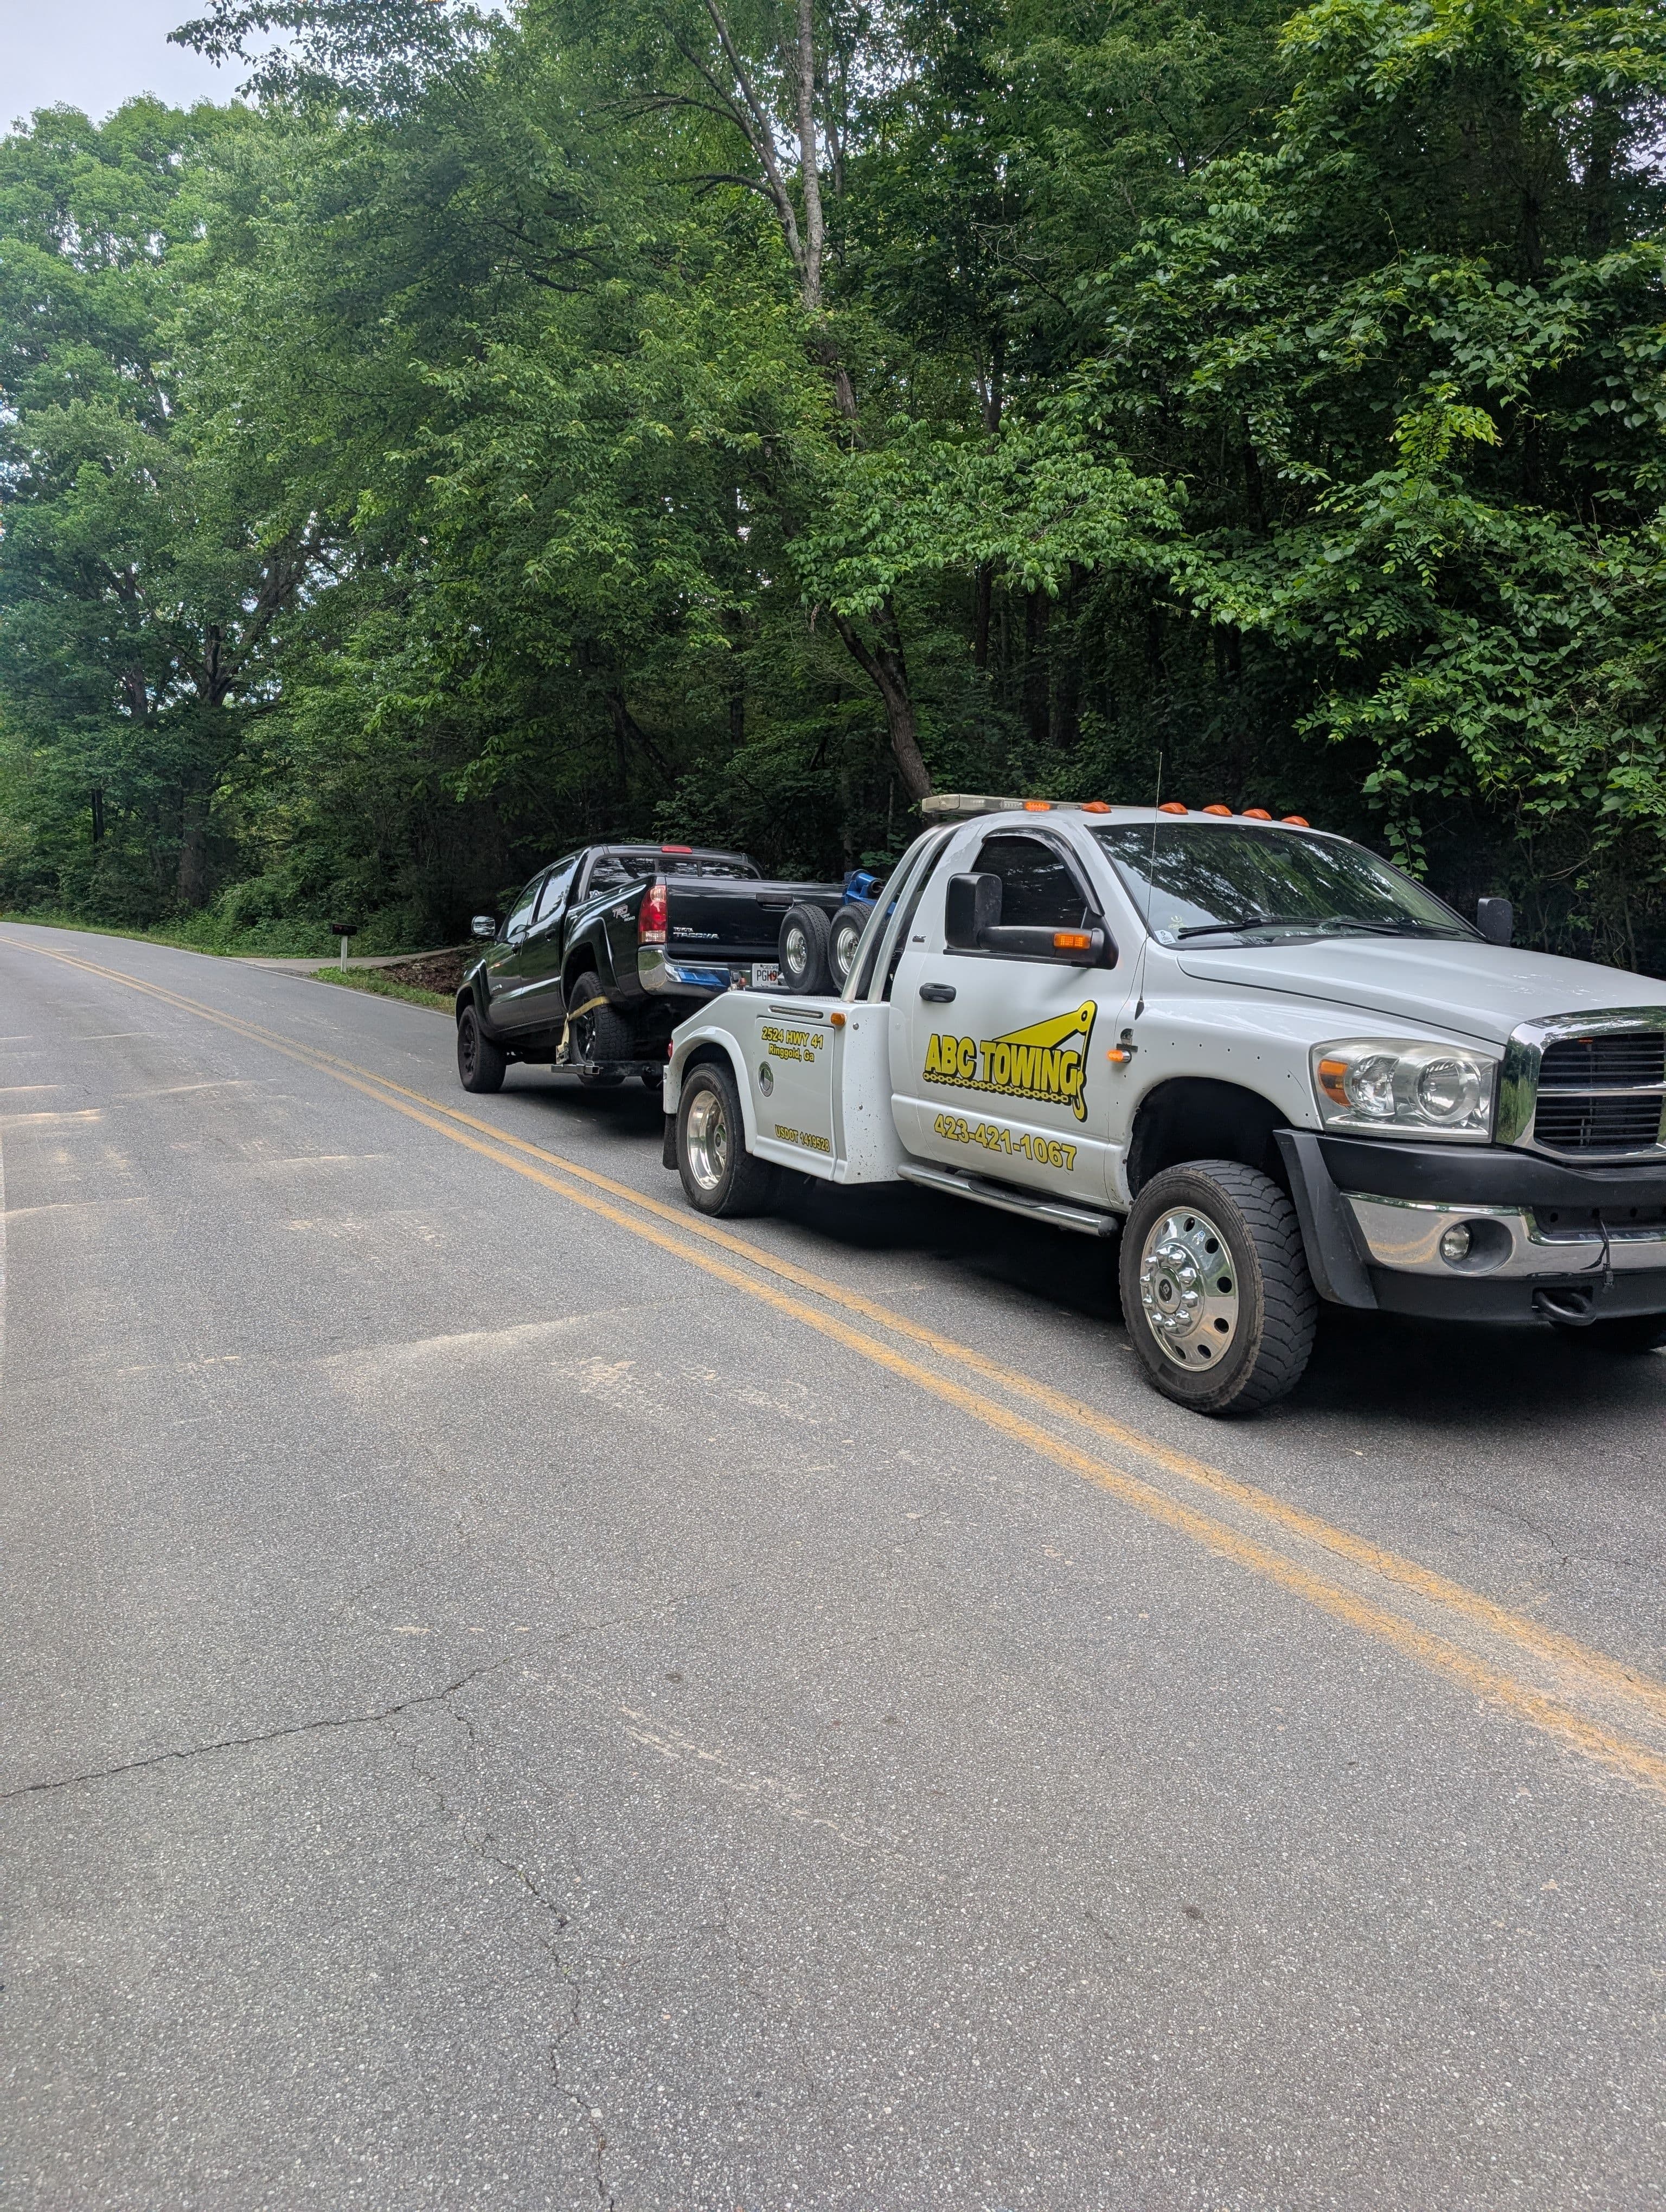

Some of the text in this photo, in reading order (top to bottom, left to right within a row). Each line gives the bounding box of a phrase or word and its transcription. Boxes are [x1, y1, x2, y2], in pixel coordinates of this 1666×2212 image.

[757, 970, 777, 981] PGH9
[761, 1026, 824, 1050] 2524 HWY 41
[768, 1043, 815, 1063] Ringgold, Ga
[924, 1033, 1080, 1096] ABC TOWING
[774, 1124, 830, 1153] USDOT 1419528
[934, 1113, 1077, 1171] 423-421-1067
